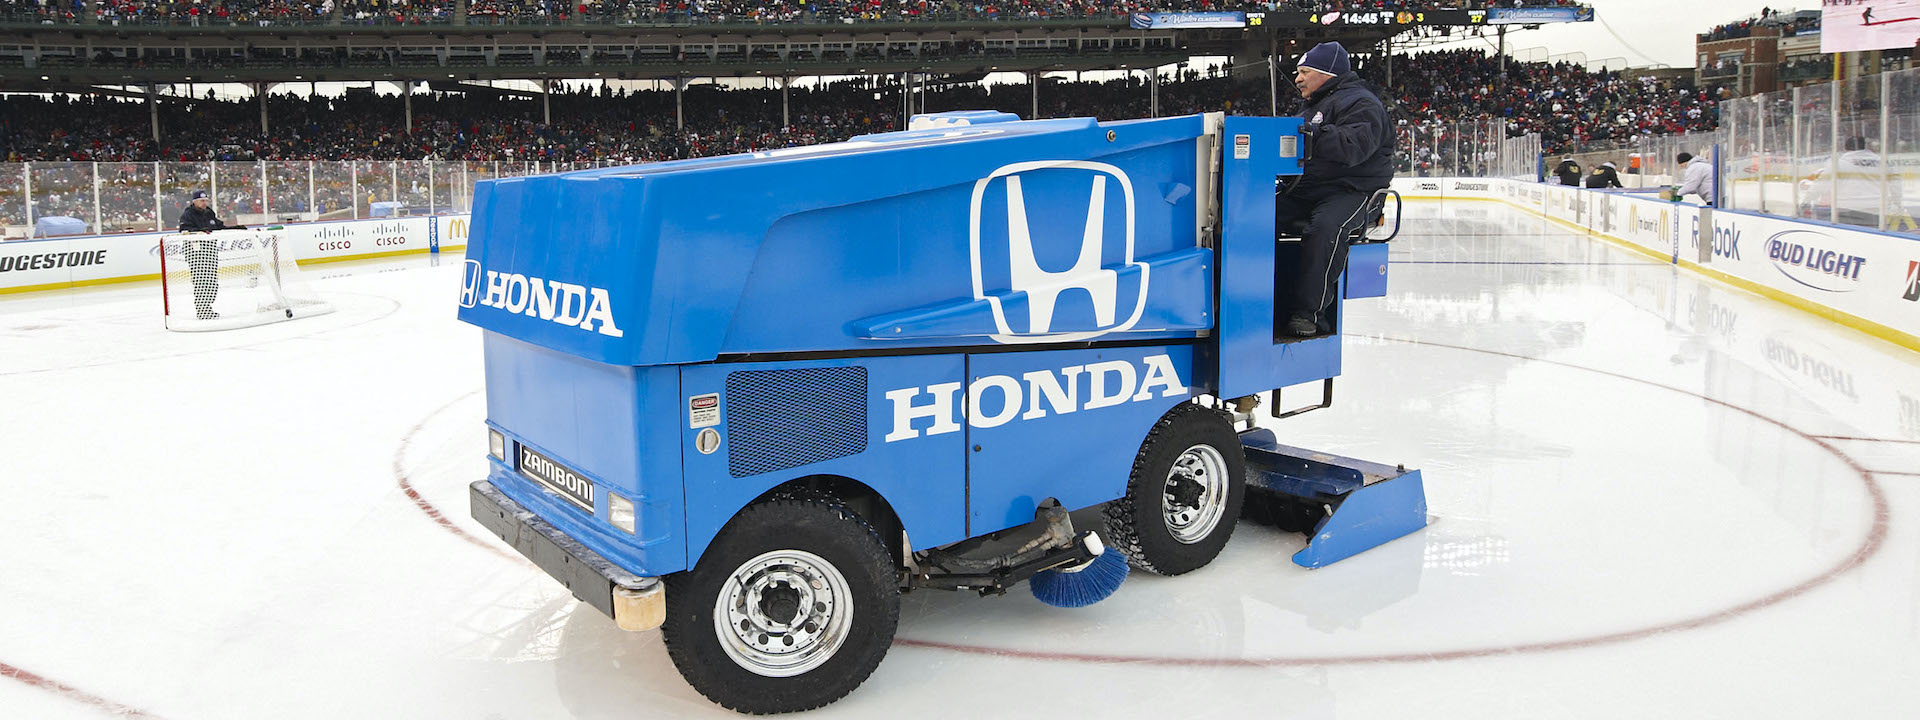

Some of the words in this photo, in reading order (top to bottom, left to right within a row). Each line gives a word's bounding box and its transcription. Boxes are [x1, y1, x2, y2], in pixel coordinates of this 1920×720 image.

[1310, 14, 1318, 23] 4
[1342, 13, 1378, 24] 14:45
[1416, 13, 1424, 22] 3
[1471, 15, 1483, 23] 27
[376, 236, 406, 246] CISCO
[1691, 215, 1741, 261] Rbok
[319, 241, 351, 251] CISCO
[1769, 239, 1804, 265] BUD
[1806, 247, 1866, 281] LIGHT
[480, 270, 624, 338] HONDA
[885, 354, 1188, 443] HONDA
[524, 449, 594, 502] ZAMBONI
